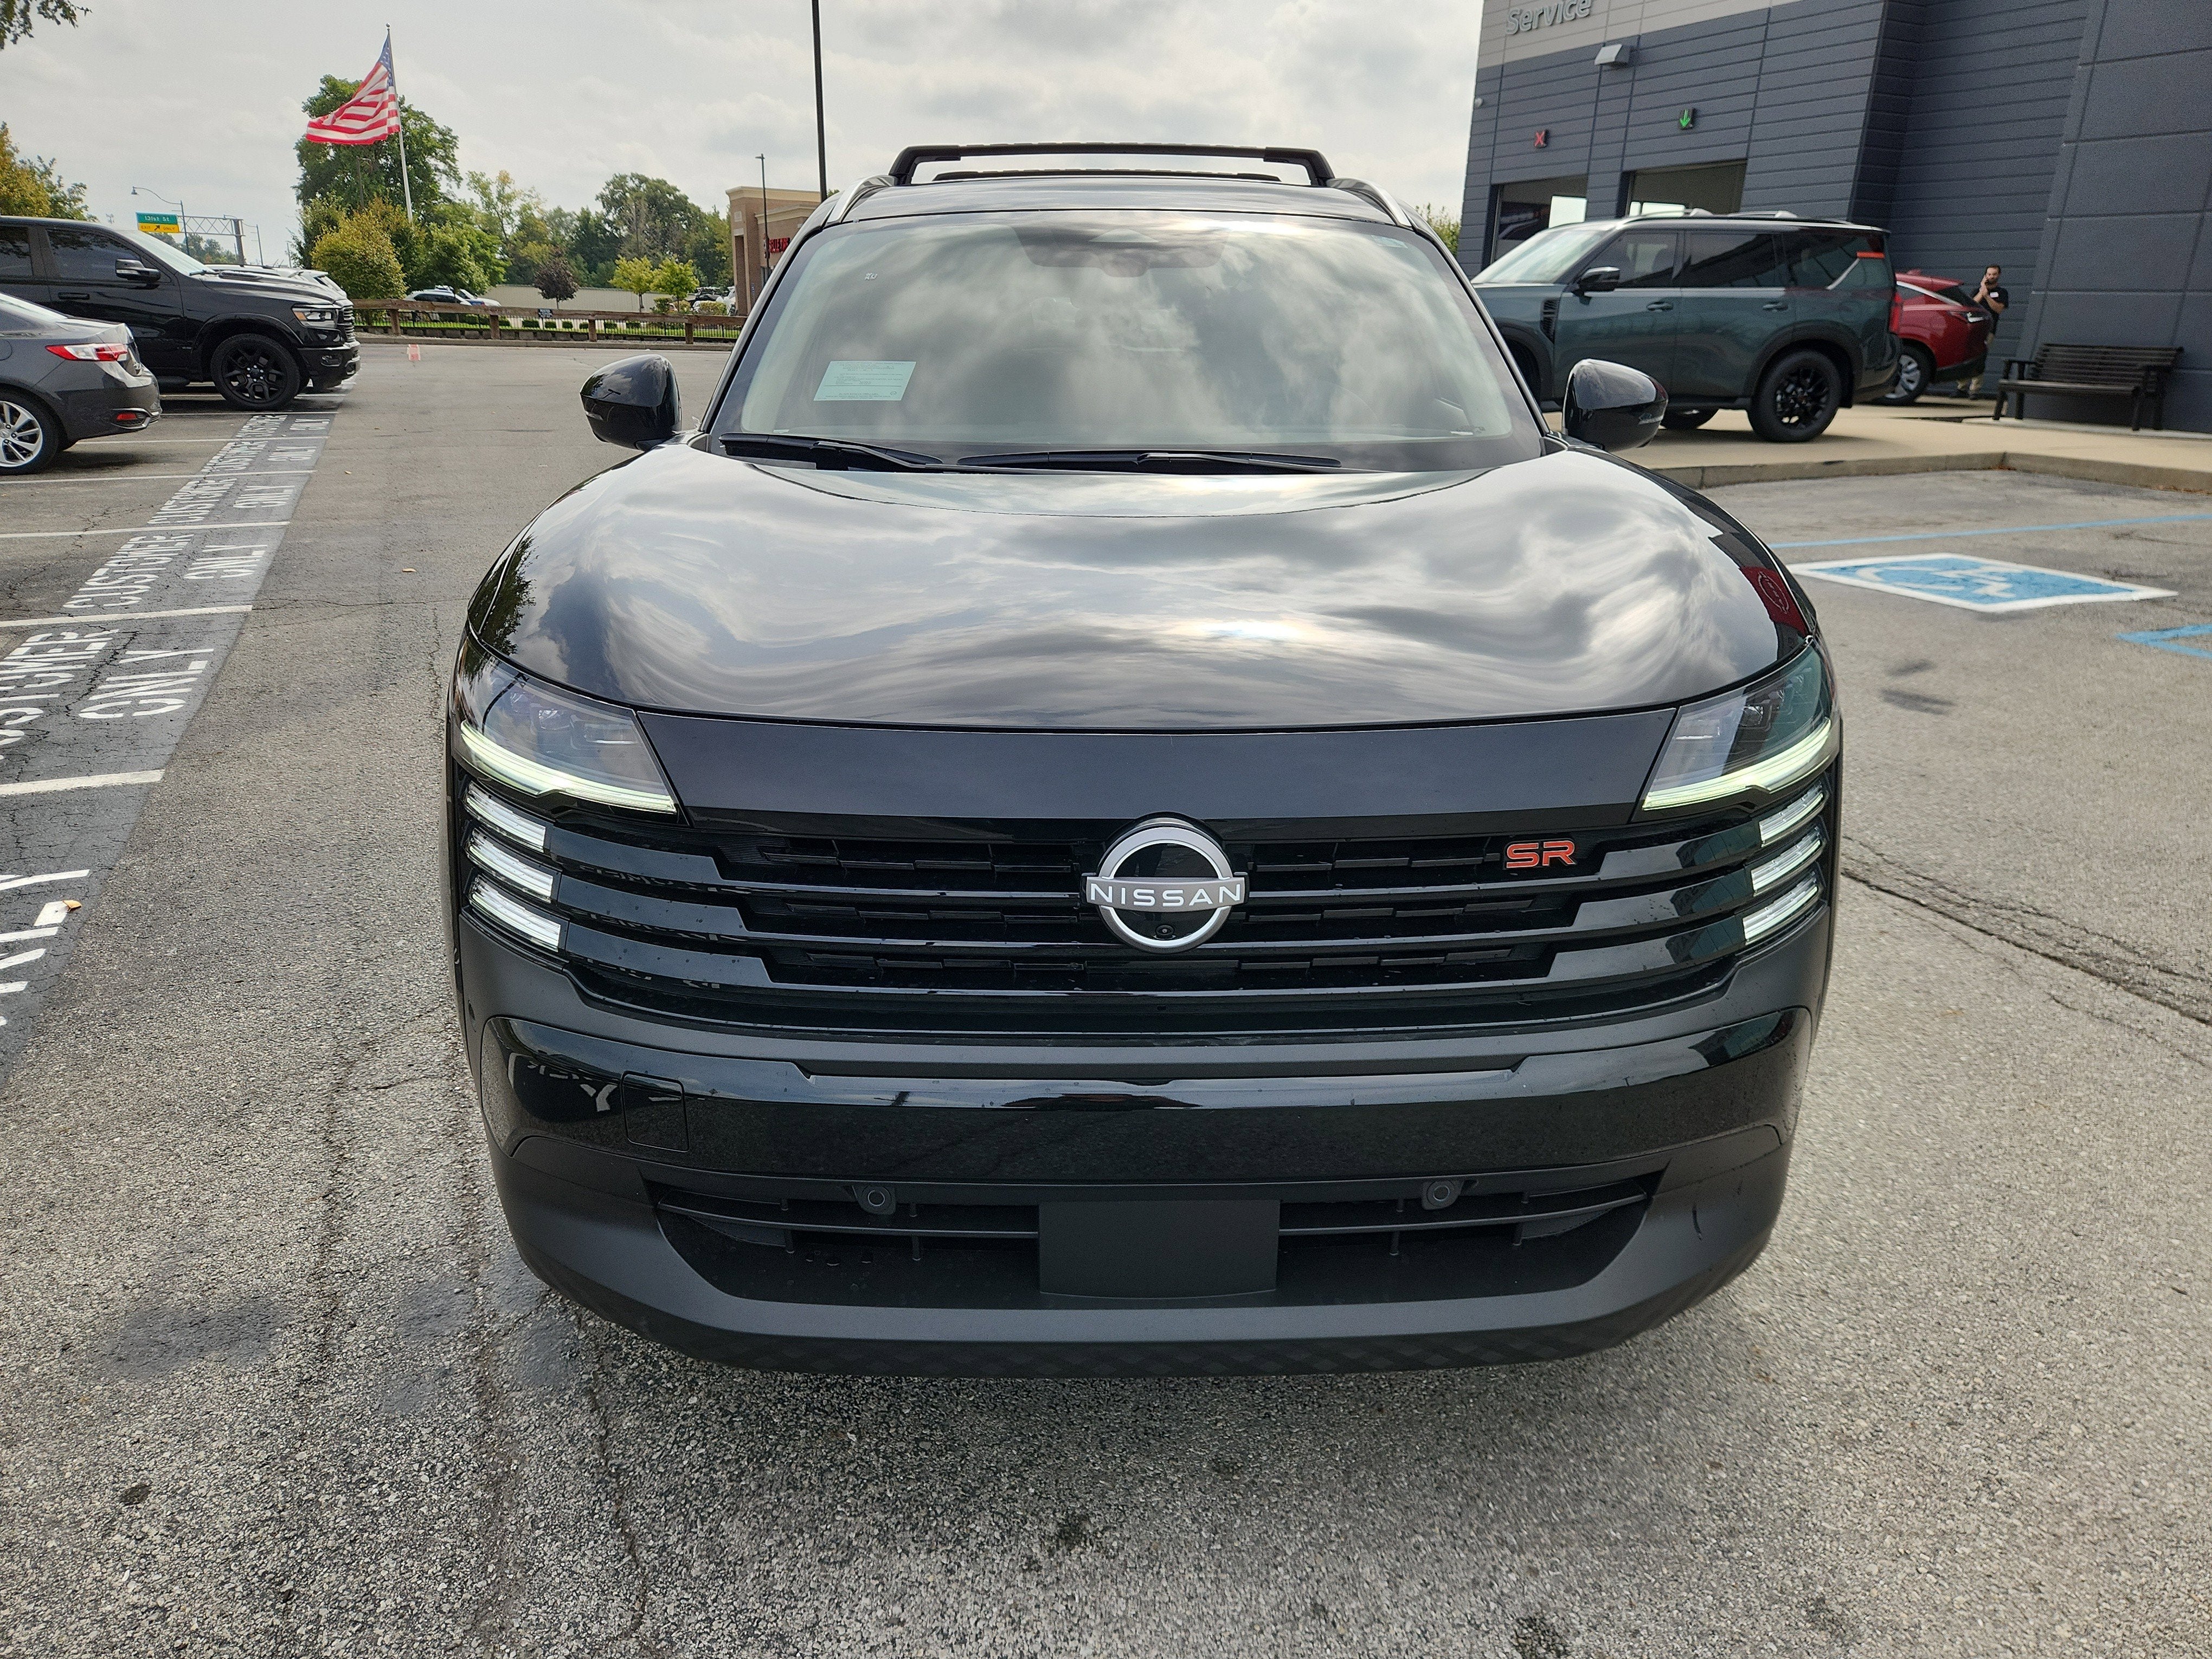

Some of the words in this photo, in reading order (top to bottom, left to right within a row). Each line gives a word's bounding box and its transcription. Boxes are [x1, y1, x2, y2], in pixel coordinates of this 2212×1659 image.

[1506, 0, 1591, 35] Service
[235, 415, 288, 438] CUSTOMER
[290, 418, 331, 430] ONLY
[201, 441, 268, 472] CUSTOMER
[267, 446, 317, 461] ONLY
[147, 478, 237, 524] CUSTOMER
[233, 485, 295, 509] ONLY
[63, 534, 194, 608] CUSTOMER
[183, 545, 268, 580] ONLY
[78, 648, 214, 719] ONLY
[1506, 840, 1576, 869] SR
[1090, 883, 1241, 908] NISSAN
